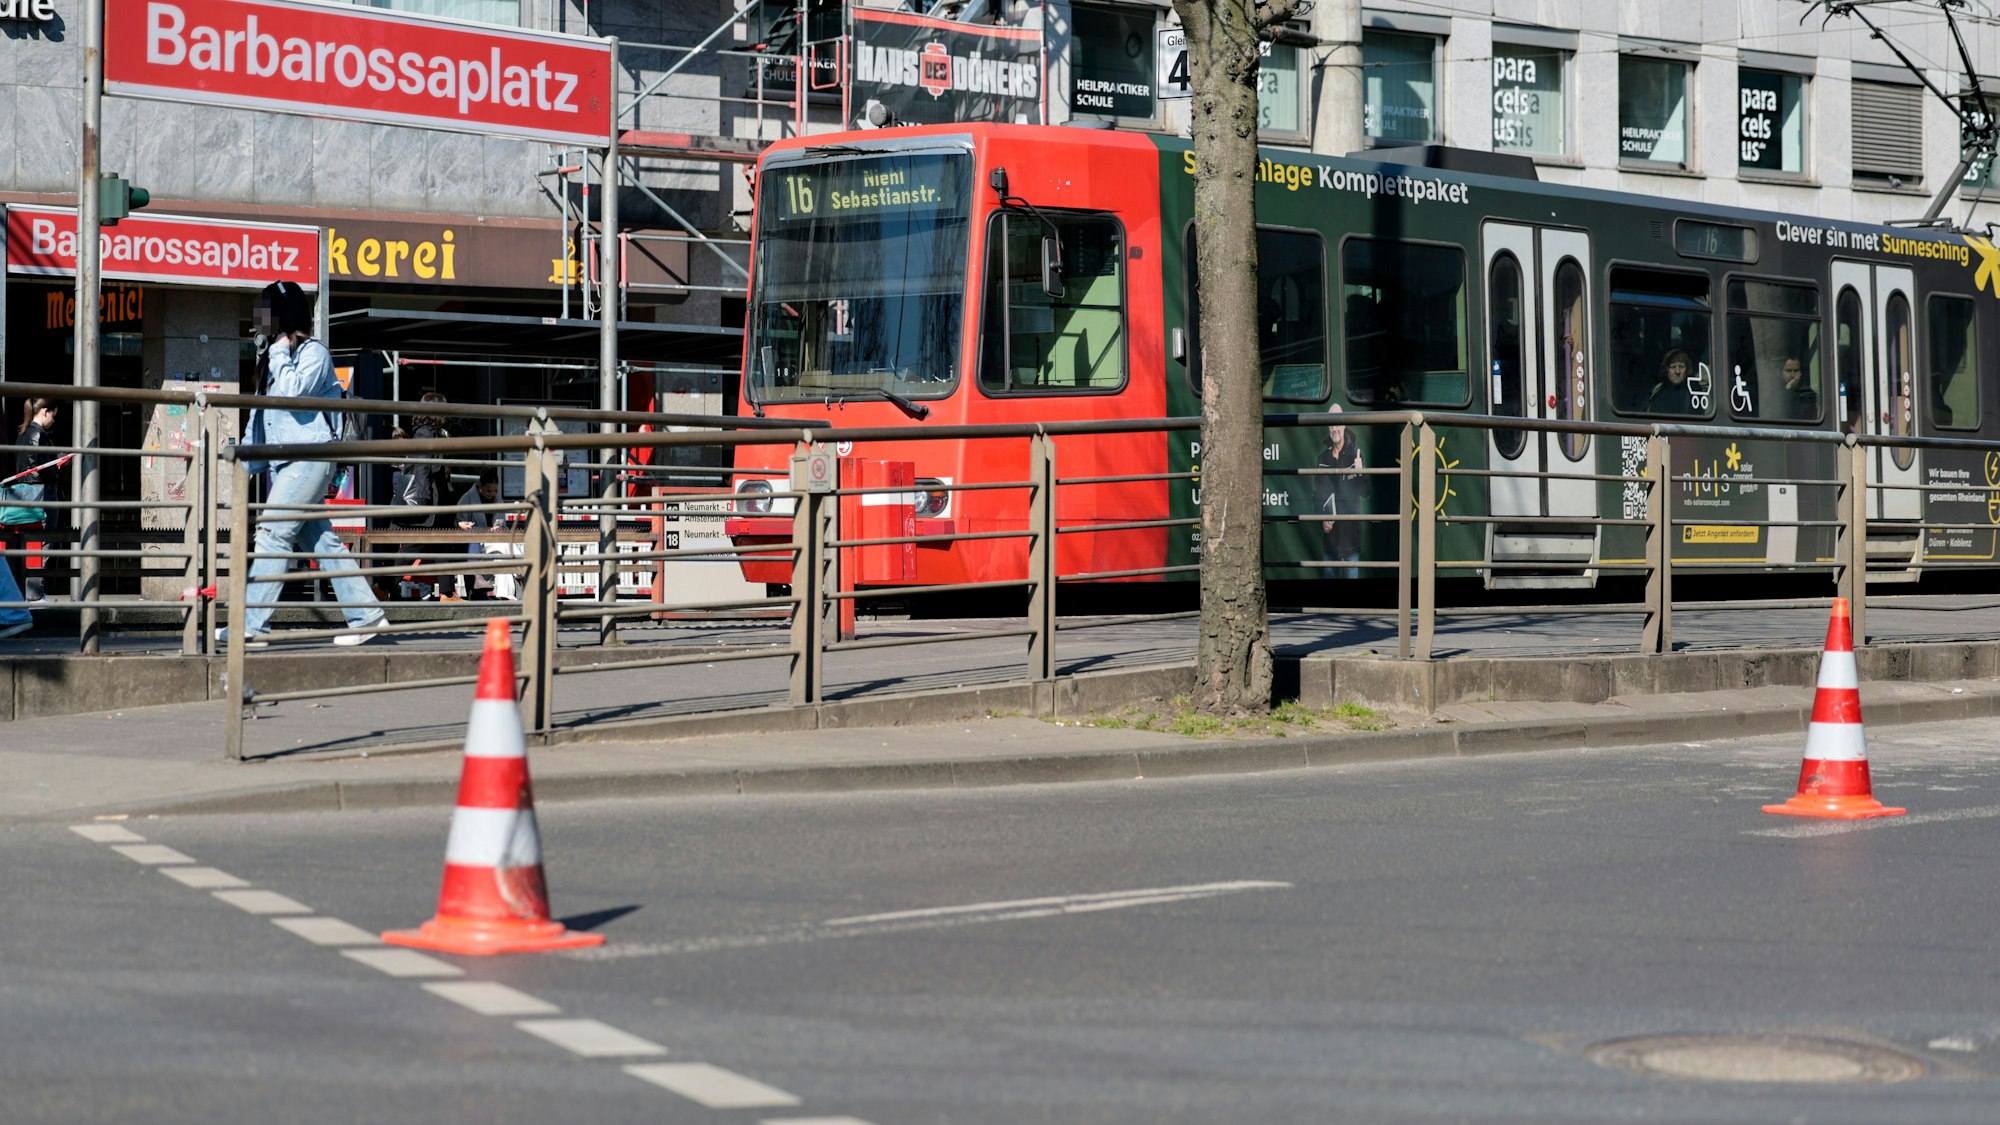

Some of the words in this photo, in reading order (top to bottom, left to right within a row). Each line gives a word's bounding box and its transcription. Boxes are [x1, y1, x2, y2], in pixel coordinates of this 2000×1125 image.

[1167, 36, 1188, 46] Glei
[146, 2, 579, 113] Barbarossaplatz
[1168, 50, 1191, 91] 4
[925, 61, 947, 80] DES
[953, 51, 1037, 98] DÖNERS
[1494, 57, 1536, 87] para
[1077, 79, 1150, 97] HEILPRAKTIKER
[1494, 86, 1529, 115] cels
[1077, 95, 1113, 108] SCHULE
[1741, 88, 1777, 115] para
[1741, 113, 1771, 139] cels
[1622, 140, 1653, 152] SCHULE
[786, 175, 814, 214] 16
[831, 184, 942, 210] Sebastianstr.
[1317, 164, 1469, 204] Komplettpaket
[1776, 220, 1823, 245] Clever
[1826, 226, 1847, 248] sin
[1851, 233, 1880, 251] met
[1882, 233, 1969, 267] Sunnesching
[1928, 468, 1939, 478] Wir
[1940, 468, 1957, 478] bauen
[1958, 469, 1970, 478] Ihre
[684, 502, 719, 511] Neumarkt
[1929, 493, 1957, 503] gesamten
[1958, 492, 1986, 502] Rheinland
[667, 533, 678, 547] 18
[684, 530, 719, 538] Neumarkt
[1707, 530, 1729, 538] Angebot
[1928, 537, 1946, 547] Düren
[1949, 538, 1973, 547] Koblenz
